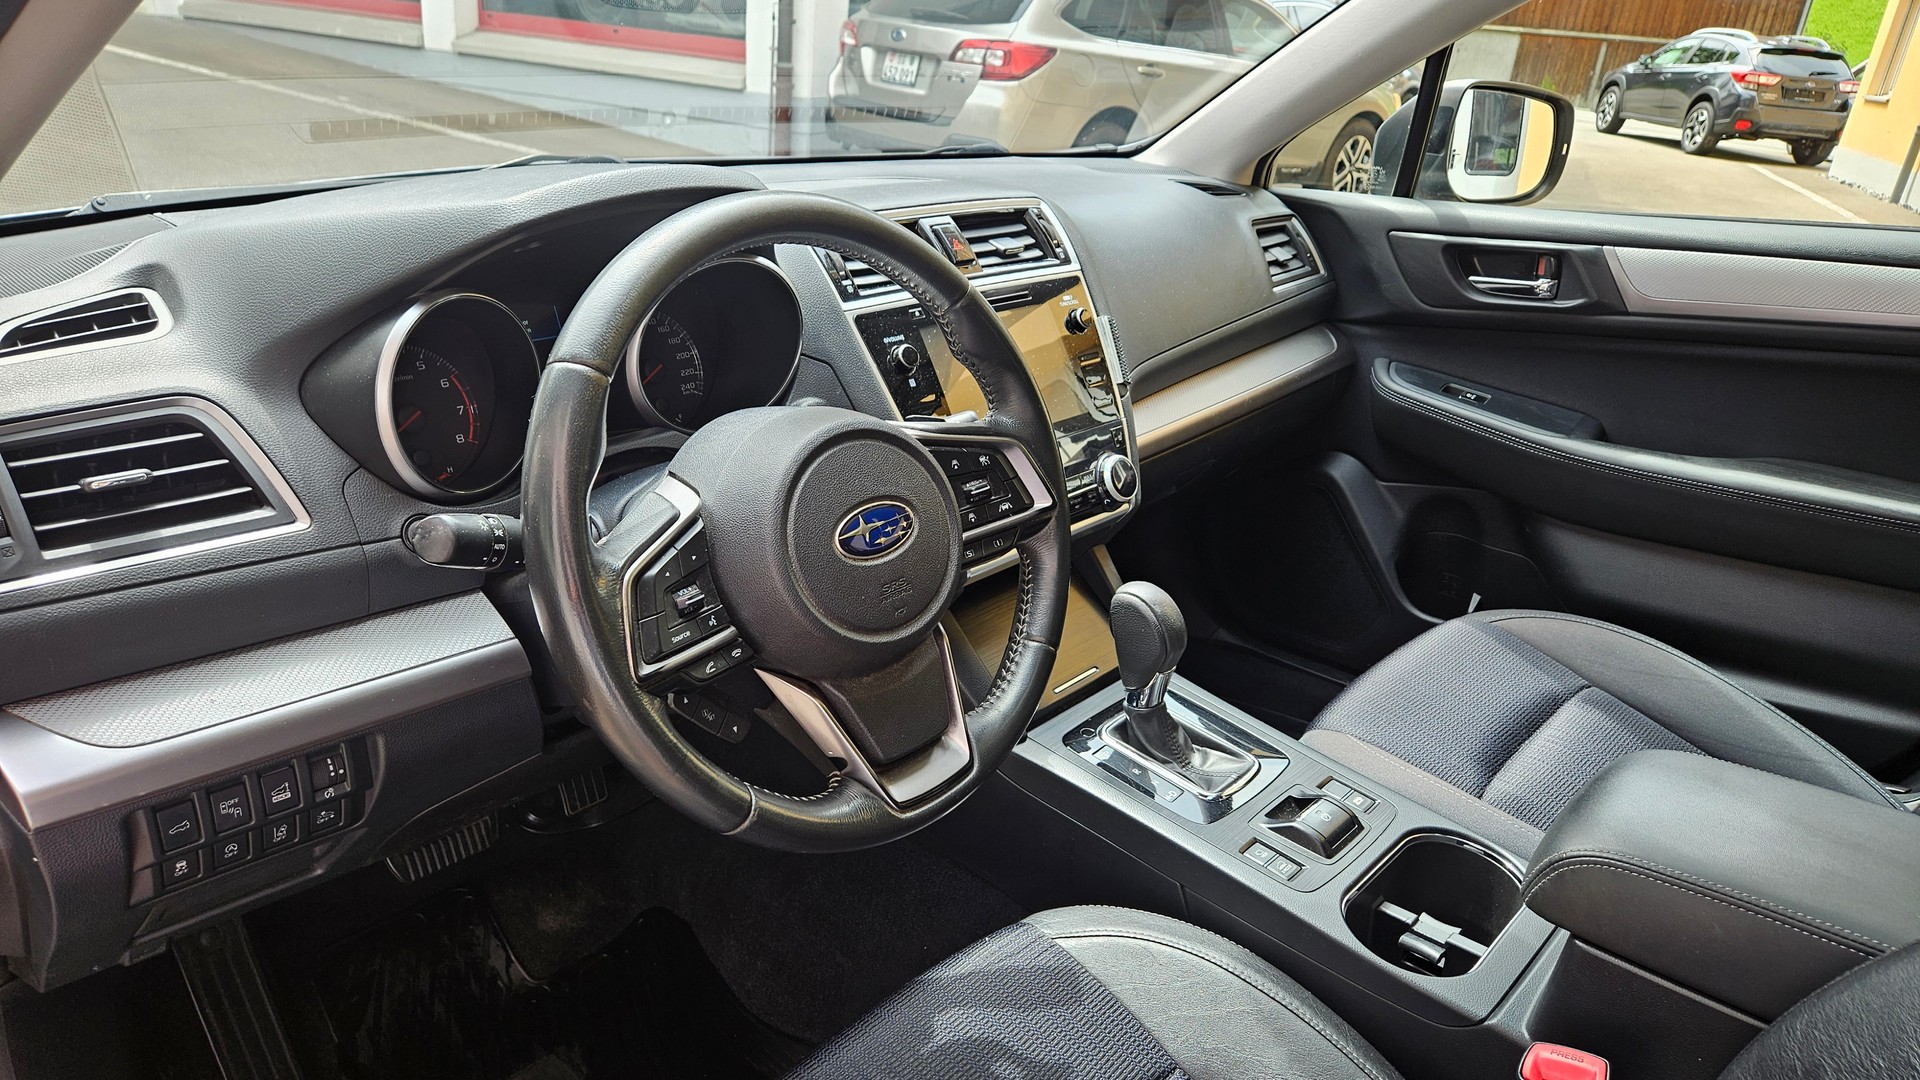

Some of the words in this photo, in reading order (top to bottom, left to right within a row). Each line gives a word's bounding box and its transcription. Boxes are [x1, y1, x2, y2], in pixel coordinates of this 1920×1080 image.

[657, 325, 670, 333] 160
[667, 337, 681, 345] 180
[676, 351, 690, 360] 200
[416, 361, 426, 371] 5
[680, 368, 695, 377] 220
[440, 378, 450, 388] 6
[680, 382, 695, 391] 240
[456, 405, 464, 415] 7
[455, 434, 465, 444] 8
[446, 466, 454, 474] H
[671, 630, 691, 644] Source
[227, 797, 240, 806] OFF
[1550, 1048, 1585, 1063] PRESS
